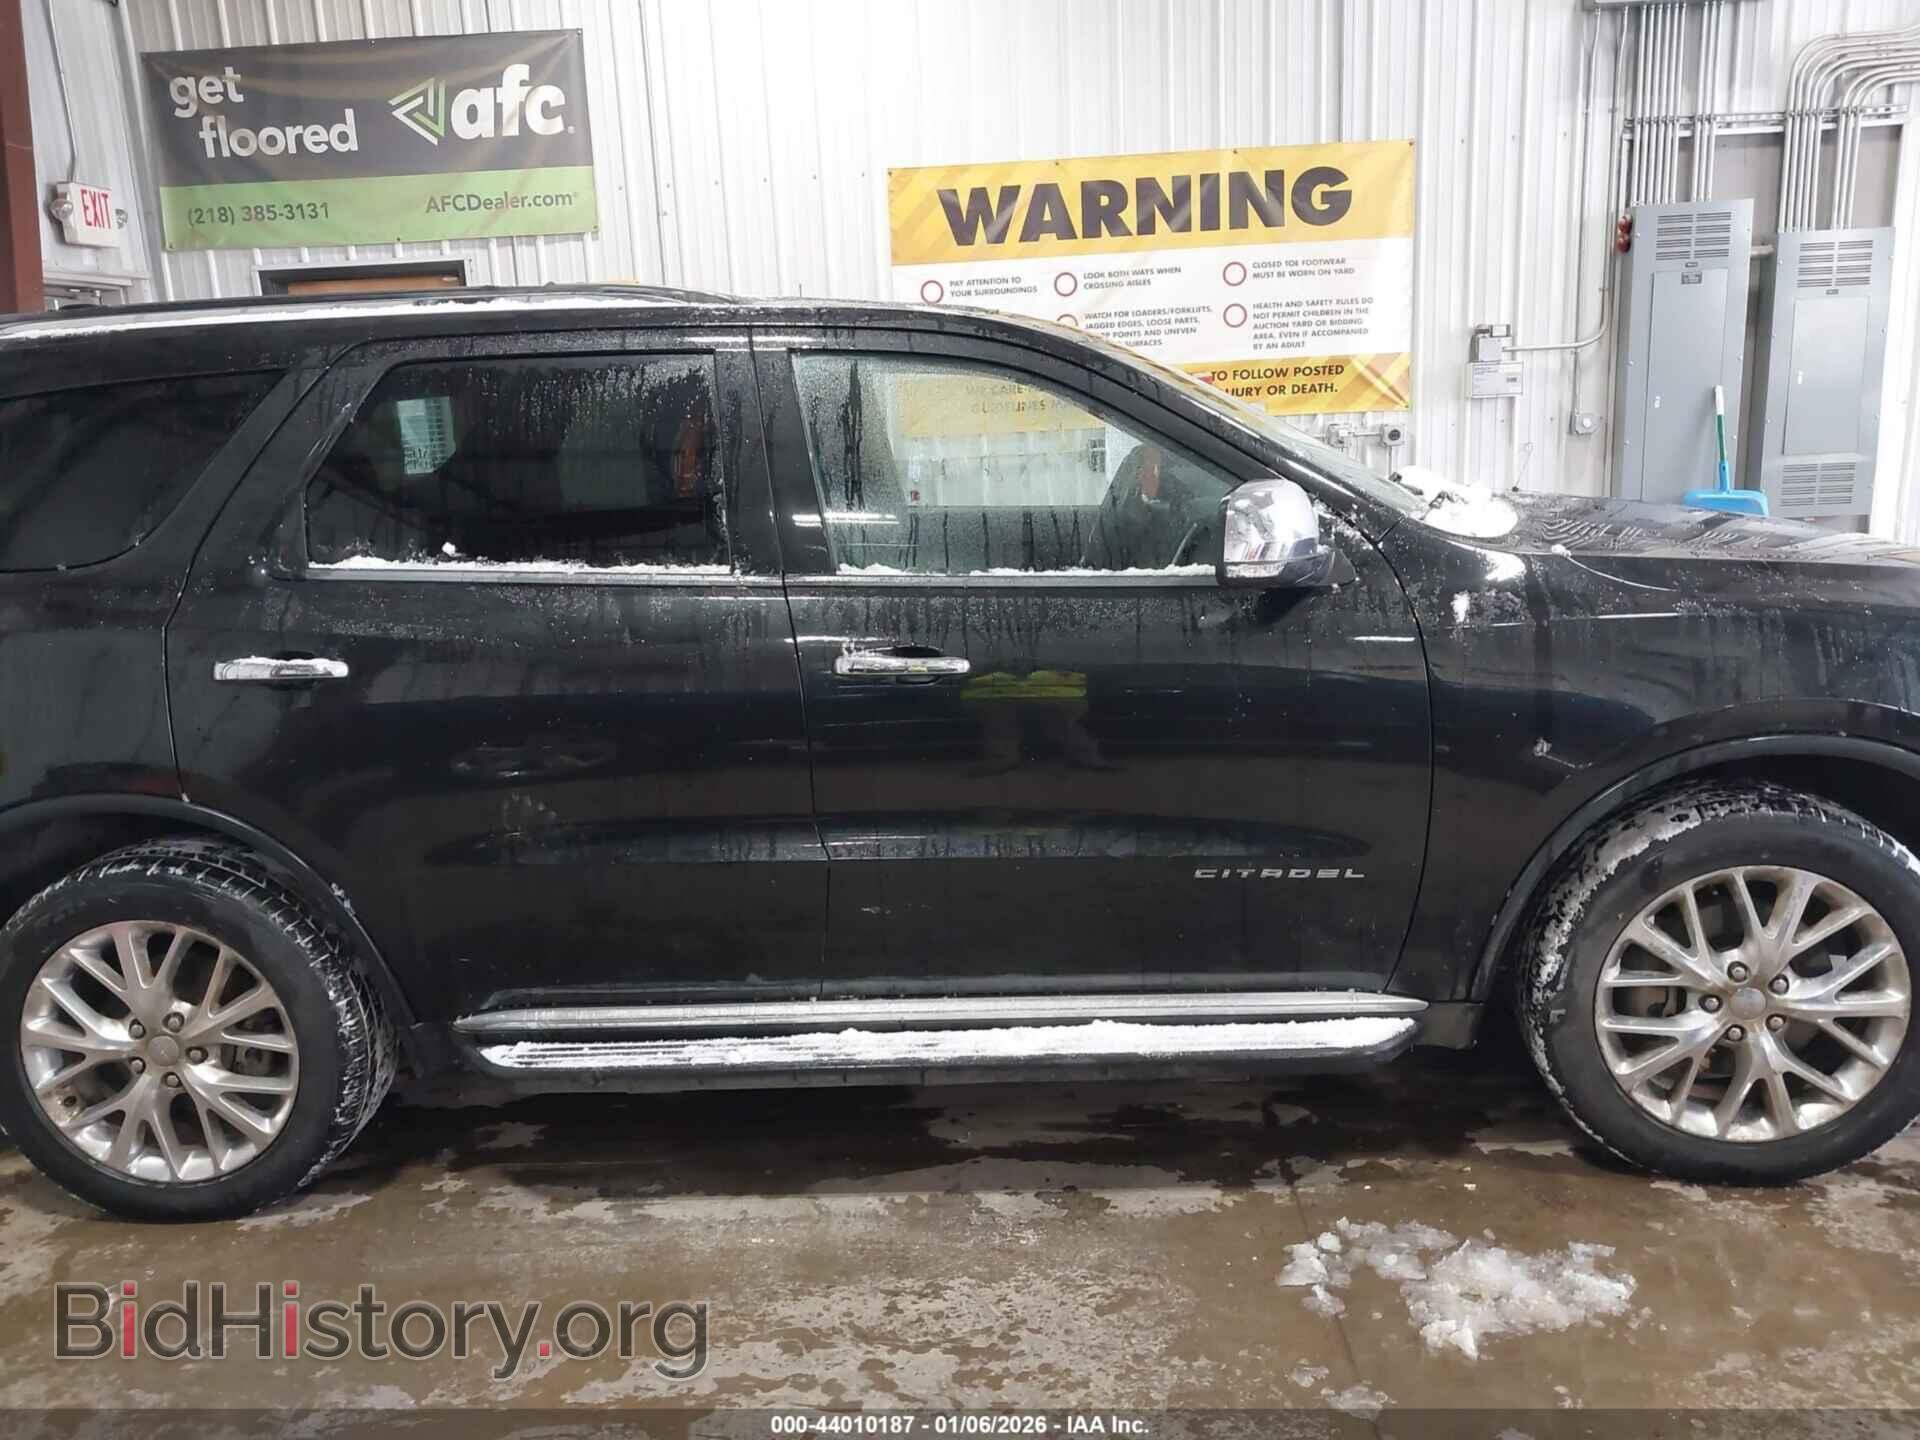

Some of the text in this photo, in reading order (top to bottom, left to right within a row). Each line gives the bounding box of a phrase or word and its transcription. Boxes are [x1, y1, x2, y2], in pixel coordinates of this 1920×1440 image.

[168, 67, 244, 118] get
[199, 108, 359, 159] floored
[80, 188, 112, 230] EXIT
[937, 165, 1353, 247] WARNING
[187, 202, 330, 226] (218) 385-3131
[1252, 257, 1346, 269] CLOSED TOE FOOTWEAR
[1083, 266, 1182, 280] LOOK BOTH WAYS WHEN
[1252, 267, 1355, 279] MUST BE WORN ON YARD
[966, 278, 1009, 286] ATTENTION
[1011, 276, 1022, 284] TO
[1083, 278, 1152, 290] CROSSING AISLES
[974, 286, 1038, 295] SURROUNDINGS
[1253, 302, 1283, 310] HEALTH
[1305, 299, 1333, 307] SAFETY
[1361, 296, 1374, 304] DO
[1084, 311, 1112, 320] WATCH
[1113, 310, 1130, 318] FOR
[1252, 312, 1270, 320] NOT
[1272, 310, 1301, 319] PERMIT
[1302, 309, 1341, 317] CHILDREN
[1084, 322, 1115, 330] JAGGED
[1146, 318, 1172, 327] LOOSE
[1252, 321, 1290, 330] AUCTION
[1291, 320, 1313, 328] YARD
[1329, 317, 1364, 326] BIDDING
[1113, 331, 1142, 339] POINTS
[1144, 329, 1162, 337] AND
[1164, 327, 1197, 335] UNEVEN
[1311, 328, 1369, 337] ACCOMPANIED
[1280, 340, 1305, 348] ADULT
[1211, 364, 1345, 382] TO FOLLOW POSTED
[1266, 383, 1286, 395] OR
[1291, 382, 1338, 394] DEATH.
[1194, 868, 1365, 878] CITADEL
